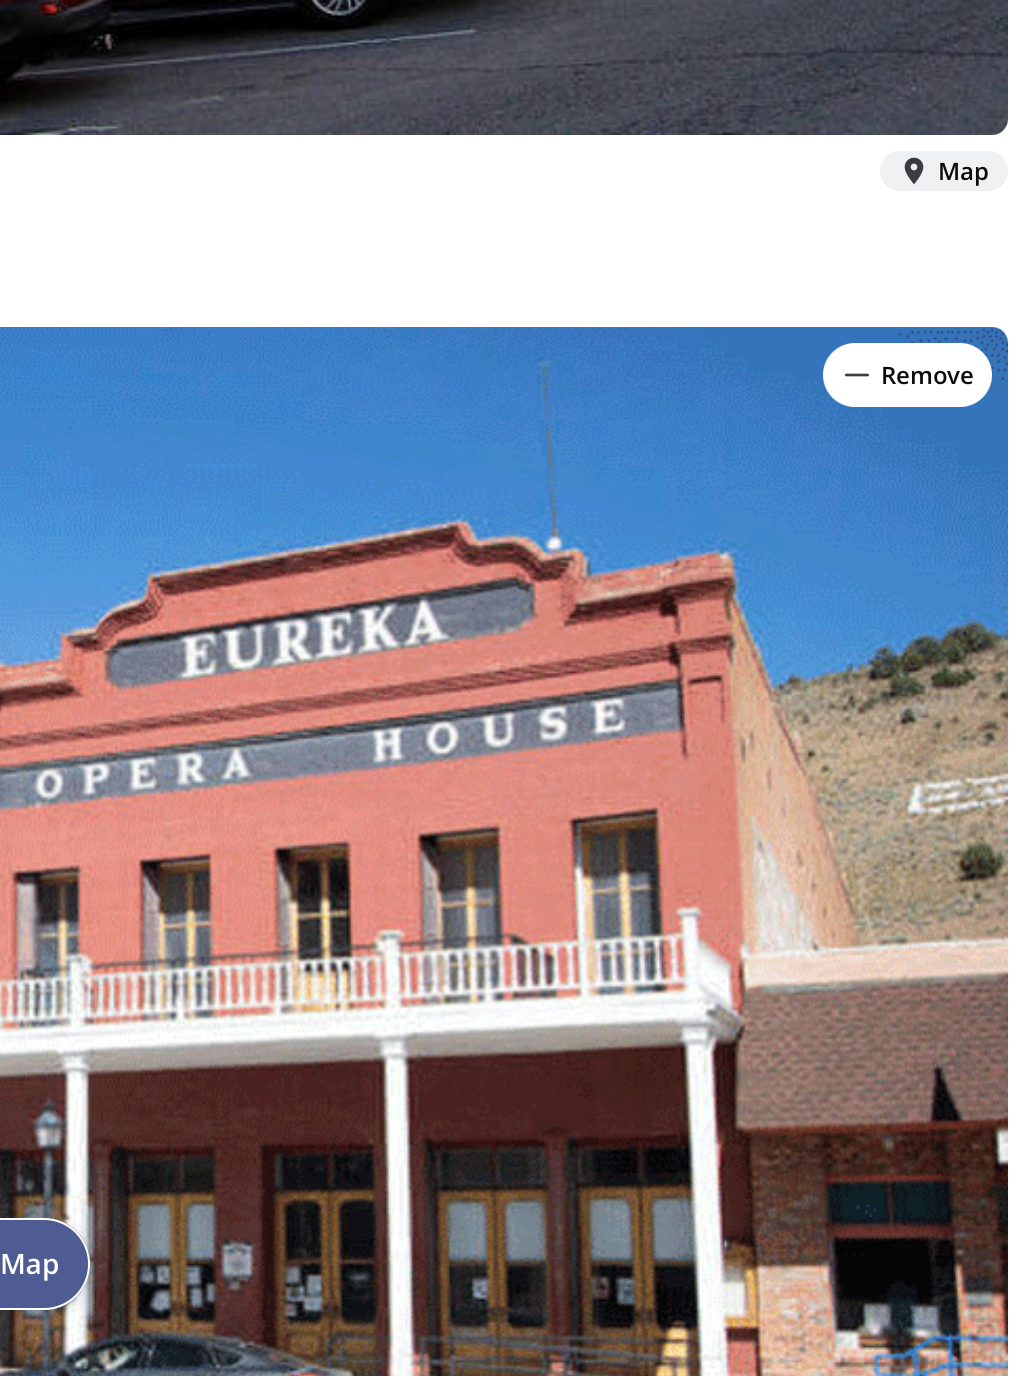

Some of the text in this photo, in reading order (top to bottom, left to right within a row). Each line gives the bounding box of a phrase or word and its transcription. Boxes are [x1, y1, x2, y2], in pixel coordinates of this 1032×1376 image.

[939, 162, 989, 187] Map
[882, 366, 974, 386] Remove
[180, 599, 450, 680] EUREKA
[35, 697, 627, 801] OPERA HOUSE
[1, 1253, 59, 1282] Map
